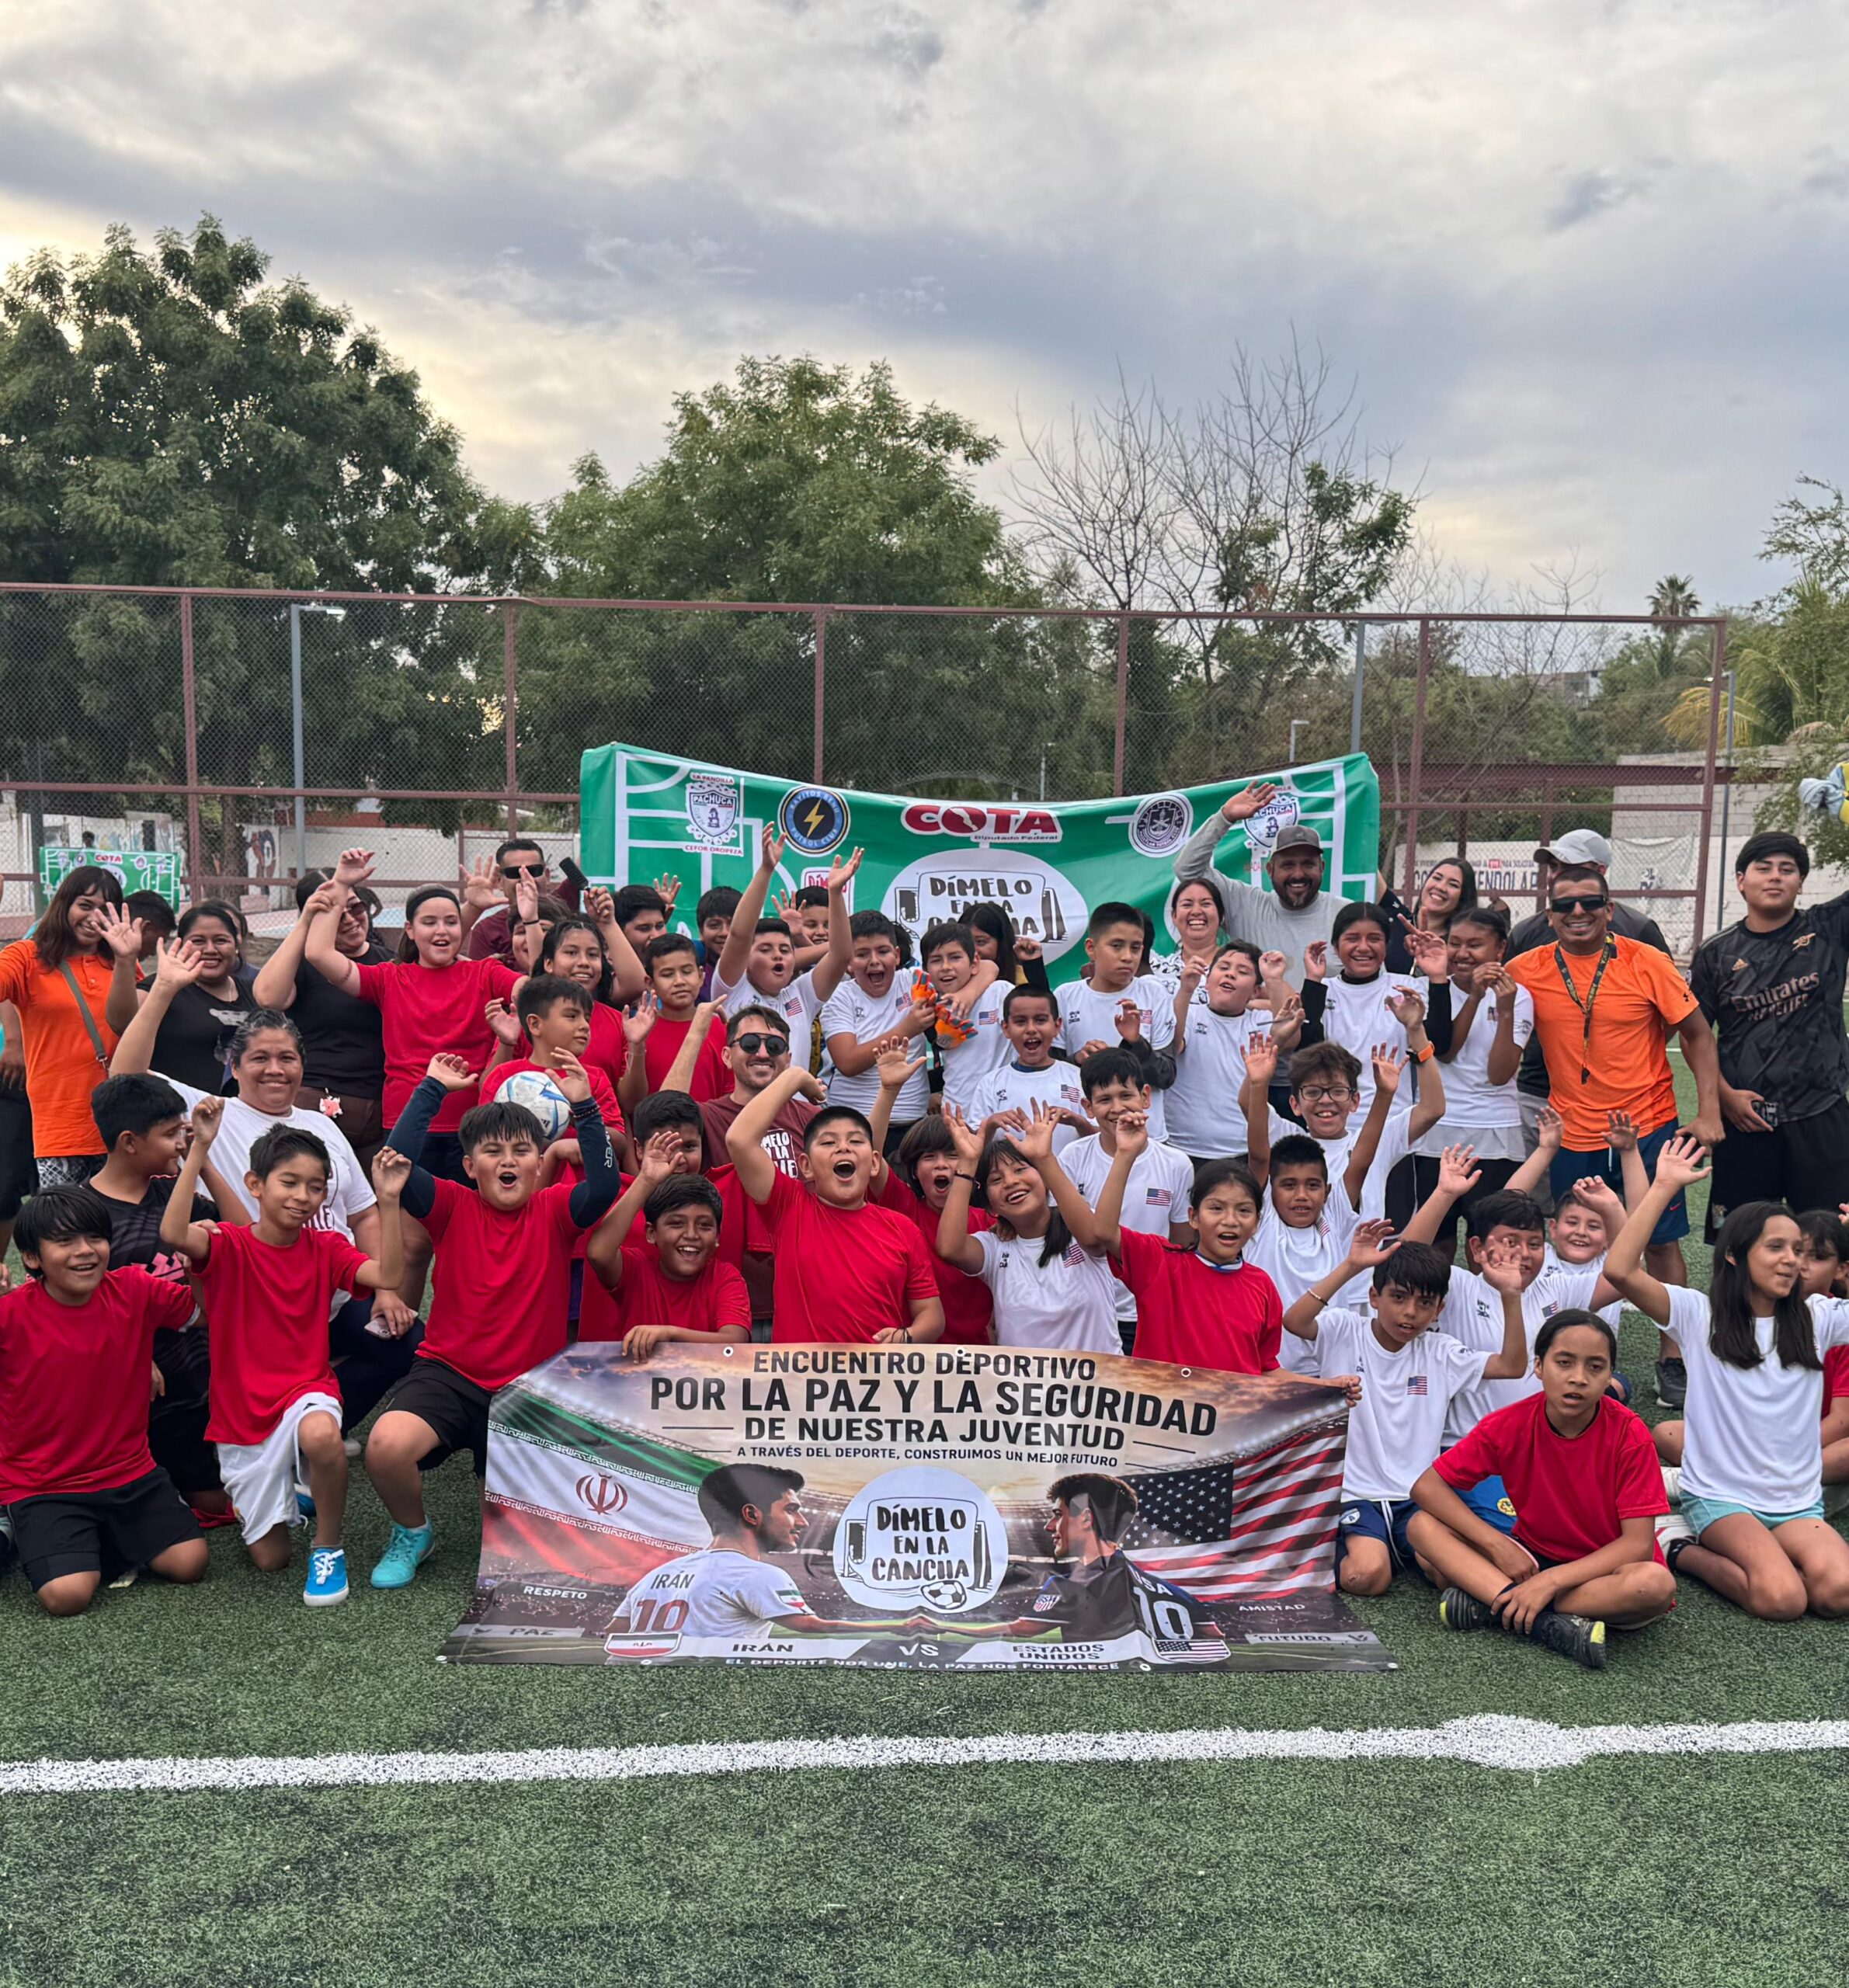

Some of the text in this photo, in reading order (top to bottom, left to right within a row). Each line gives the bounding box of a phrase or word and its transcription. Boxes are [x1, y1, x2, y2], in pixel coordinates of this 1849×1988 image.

[693, 794, 733, 806] PACHUCA
[905, 805, 1058, 834] COTA
[710, 846, 743, 855] OROPEZA
[930, 875, 1032, 897] DÍMELO
[1731, 972, 1819, 1012] Emirates
[754, 1351, 1095, 1381] ENCUENTRO DEPORTIVO
[651, 1377, 1217, 1437] POR LA PAZ Y LA SEGURIDAD
[745, 1417, 1124, 1451] DE NUESTRA JUVENTUD
[737, 1444, 1117, 1467] A TRAVÉS DEL DEPORTE, CONSTRUIMOS UN MEJOR FUTURO
[877, 1504, 966, 1532] DÍMELO
[894, 1536, 949, 1555] EN LA
[650, 1571, 695, 1590] IRÁN
[1128, 1564, 1174, 1597] USA
[523, 1586, 588, 1600] RESPETO
[632, 1599, 690, 1632] 10
[1134, 1587, 1194, 1640] 10
[509, 1628, 556, 1636] PAZ
[898, 1642, 940, 1656] VS
[1013, 1644, 1104, 1653] ESTADOS
